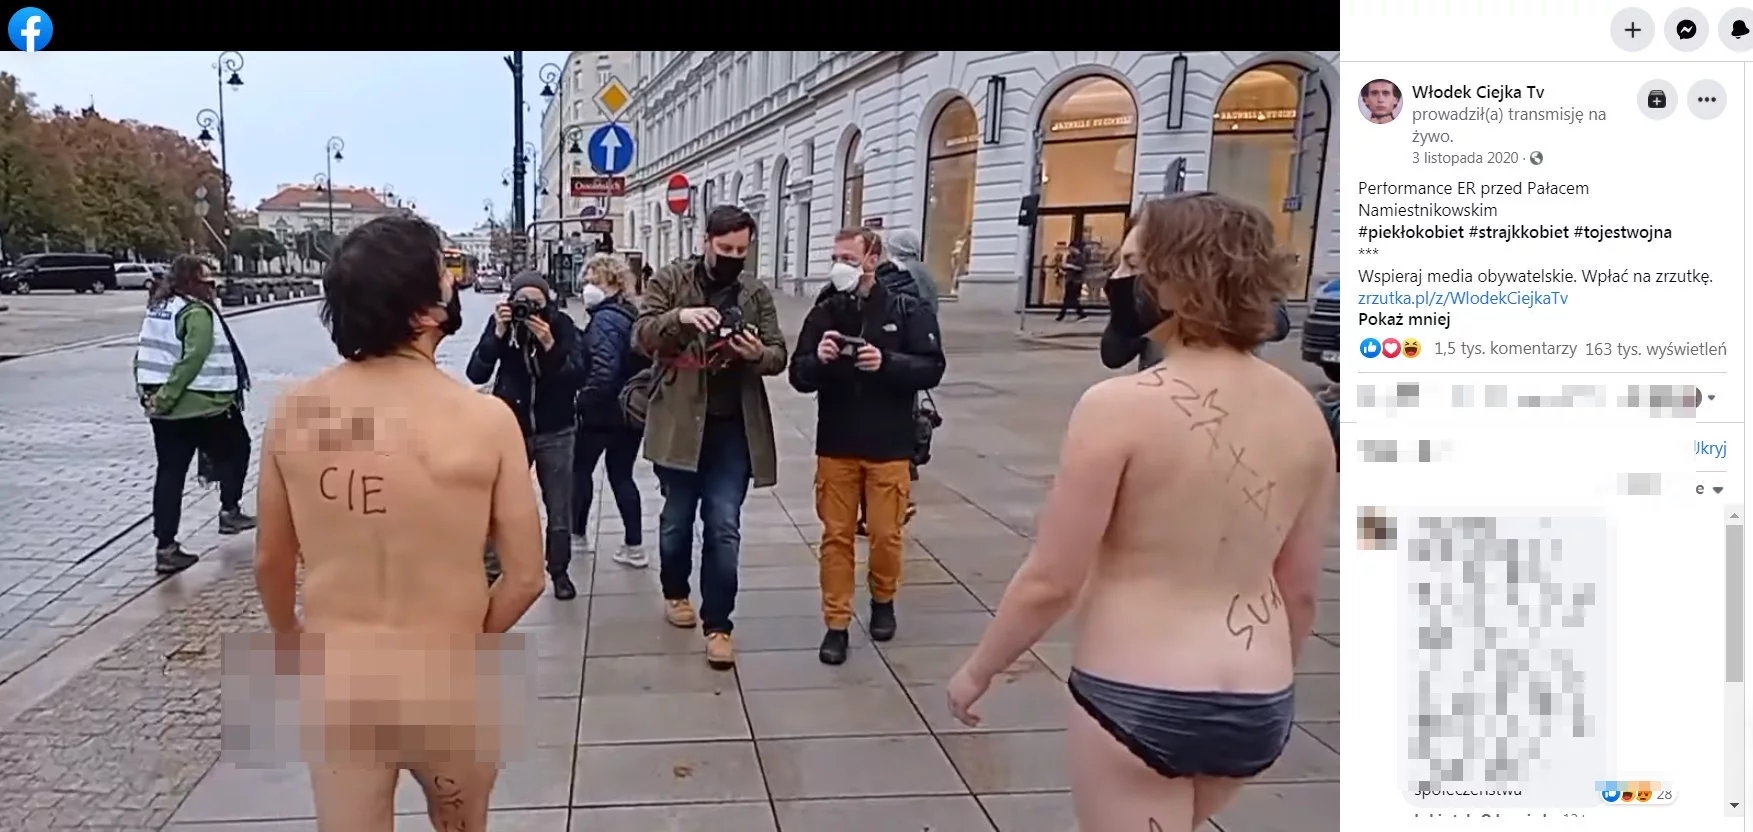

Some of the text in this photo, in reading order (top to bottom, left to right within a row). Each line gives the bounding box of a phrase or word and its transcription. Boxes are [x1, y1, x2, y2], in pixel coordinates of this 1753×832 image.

[1412, 85, 1545, 102] Włodek Ciejka Tv
[1412, 107, 1606, 124] prowadził(a) transmisję na
[1412, 130, 1454, 147] żywo.
[1412, 152, 1519, 167] 3 listopada 2020
[1358, 181, 1590, 199] Performance ER przed Pałacem
[1358, 203, 1498, 217] Namiestnikowskim
[1358, 225, 1672, 242] #piekłokobiet #strajkkobiet #tojestwojna
[1358, 268, 1713, 287] Wspieraj media obywatelskie. Wpłać na zrzutkę.
[1358, 291, 1569, 308] zrzutka.pl/z/WlodekCiejkaTv
[1359, 312, 1451, 329] Pokaż mniej
[1435, 341, 1578, 359] 1,5 tys. komentarzy
[1585, 341, 1727, 359] 163 tys. wyświetleń
